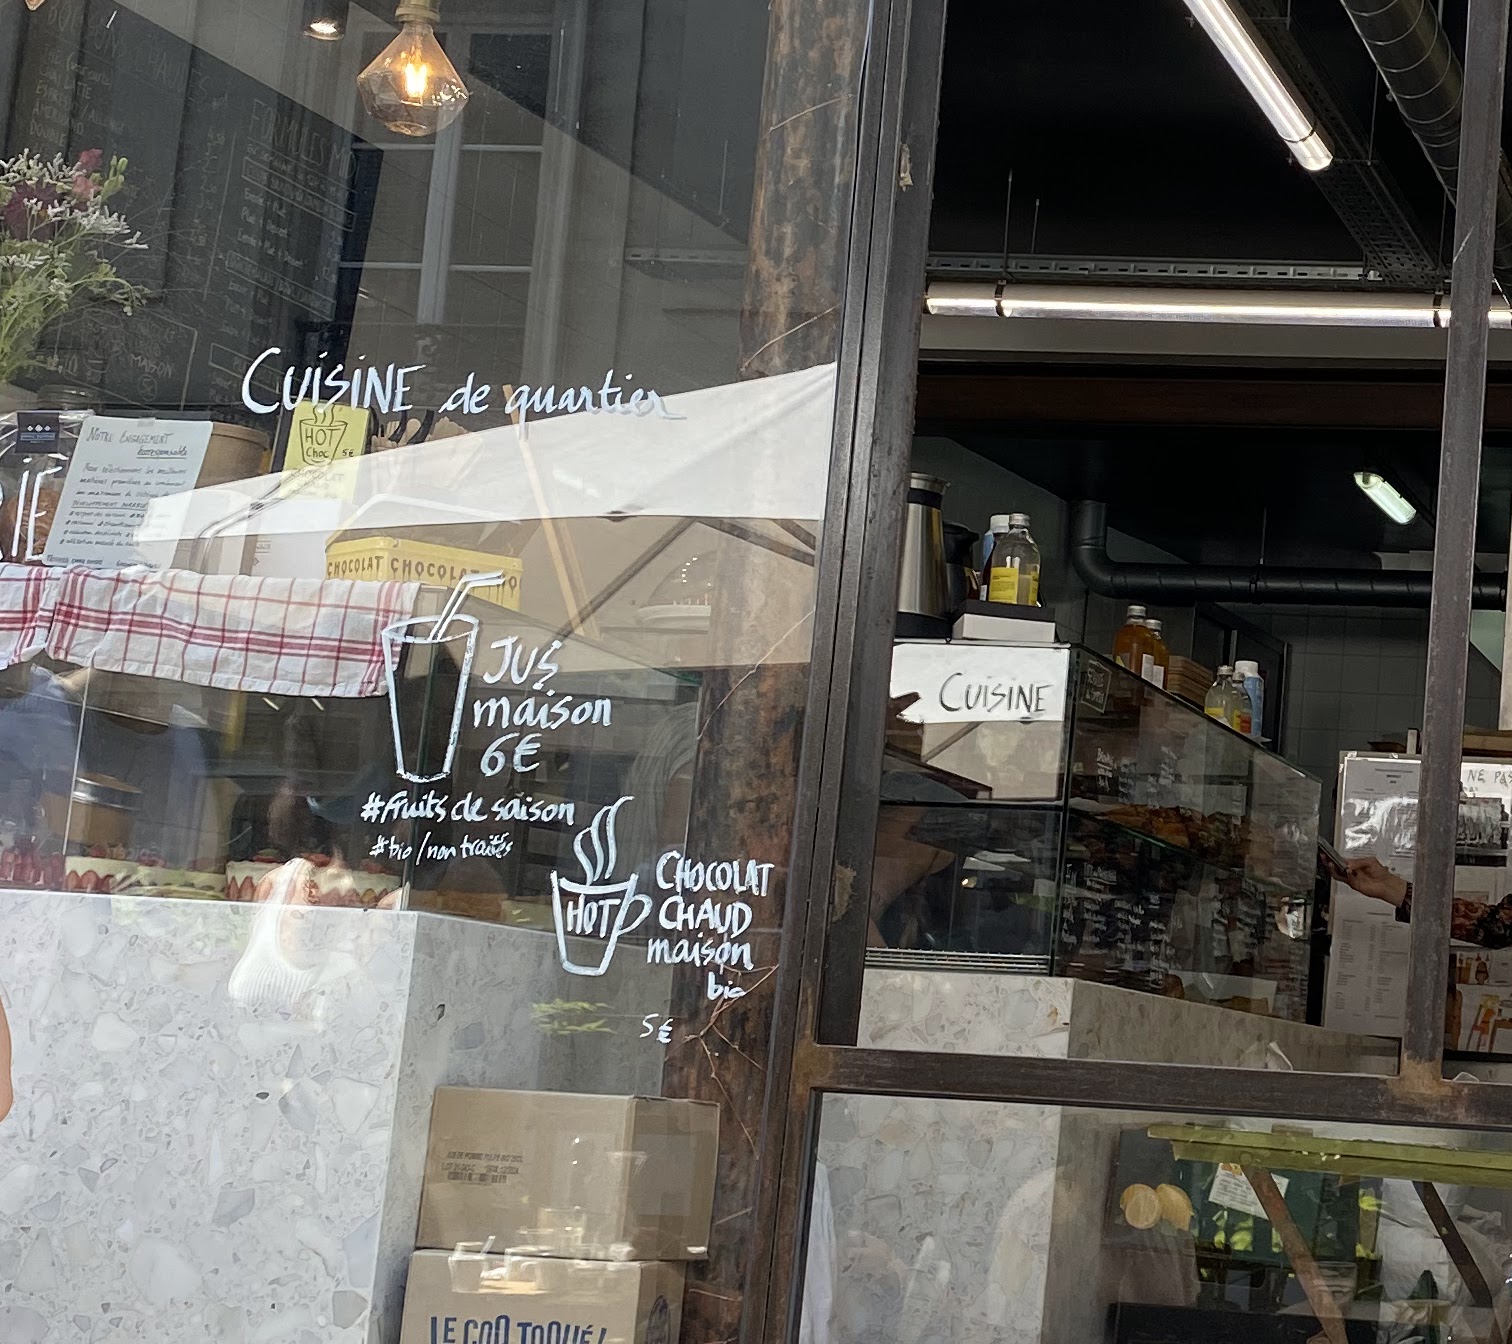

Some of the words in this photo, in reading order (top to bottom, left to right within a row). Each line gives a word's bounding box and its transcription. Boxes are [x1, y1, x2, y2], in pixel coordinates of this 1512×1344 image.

[438, 372, 490, 414] de
[503, 368, 687, 442] quartier
[304, 426, 335, 449] HOT
[326, 555, 384, 577] CHOCOLAT
[473, 689, 612, 730] maison
[938, 671, 1053, 716] CUISINE
[479, 732, 543, 778] 6€
[1466, 768, 1486, 784] NE
[451, 791, 489, 823] de
[490, 793, 575, 825] saison
[655, 850, 776, 897] CHOCOLAT
[566, 893, 621, 939] HOT
[658, 894, 754, 940] CHAUD
[646, 931, 755, 972] maison
[706, 971, 747, 1002] bio
